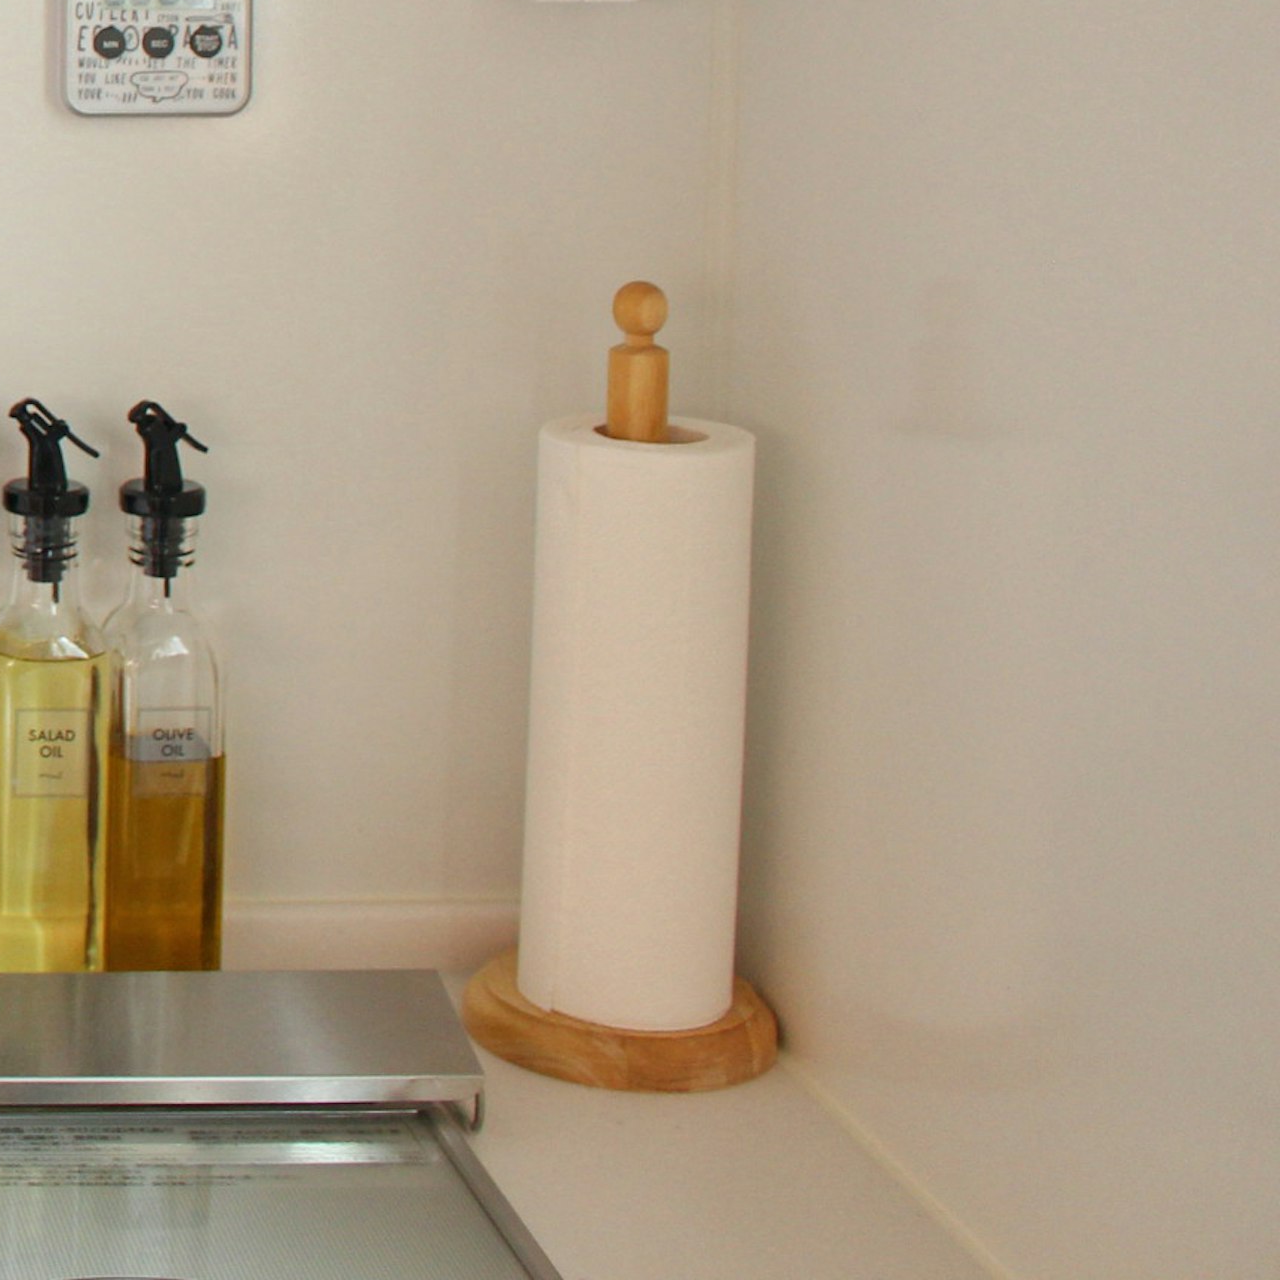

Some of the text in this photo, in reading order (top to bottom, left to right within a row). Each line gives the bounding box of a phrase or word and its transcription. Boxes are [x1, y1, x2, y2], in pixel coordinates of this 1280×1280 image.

[177, 58, 196, 69] THE
[105, 72, 126, 84] LIKE
[28, 729, 76, 742] SALAD
[152, 728, 196, 742] OLIVE
[40, 745, 64, 758] OIL
[161, 745, 185, 758] OIL
